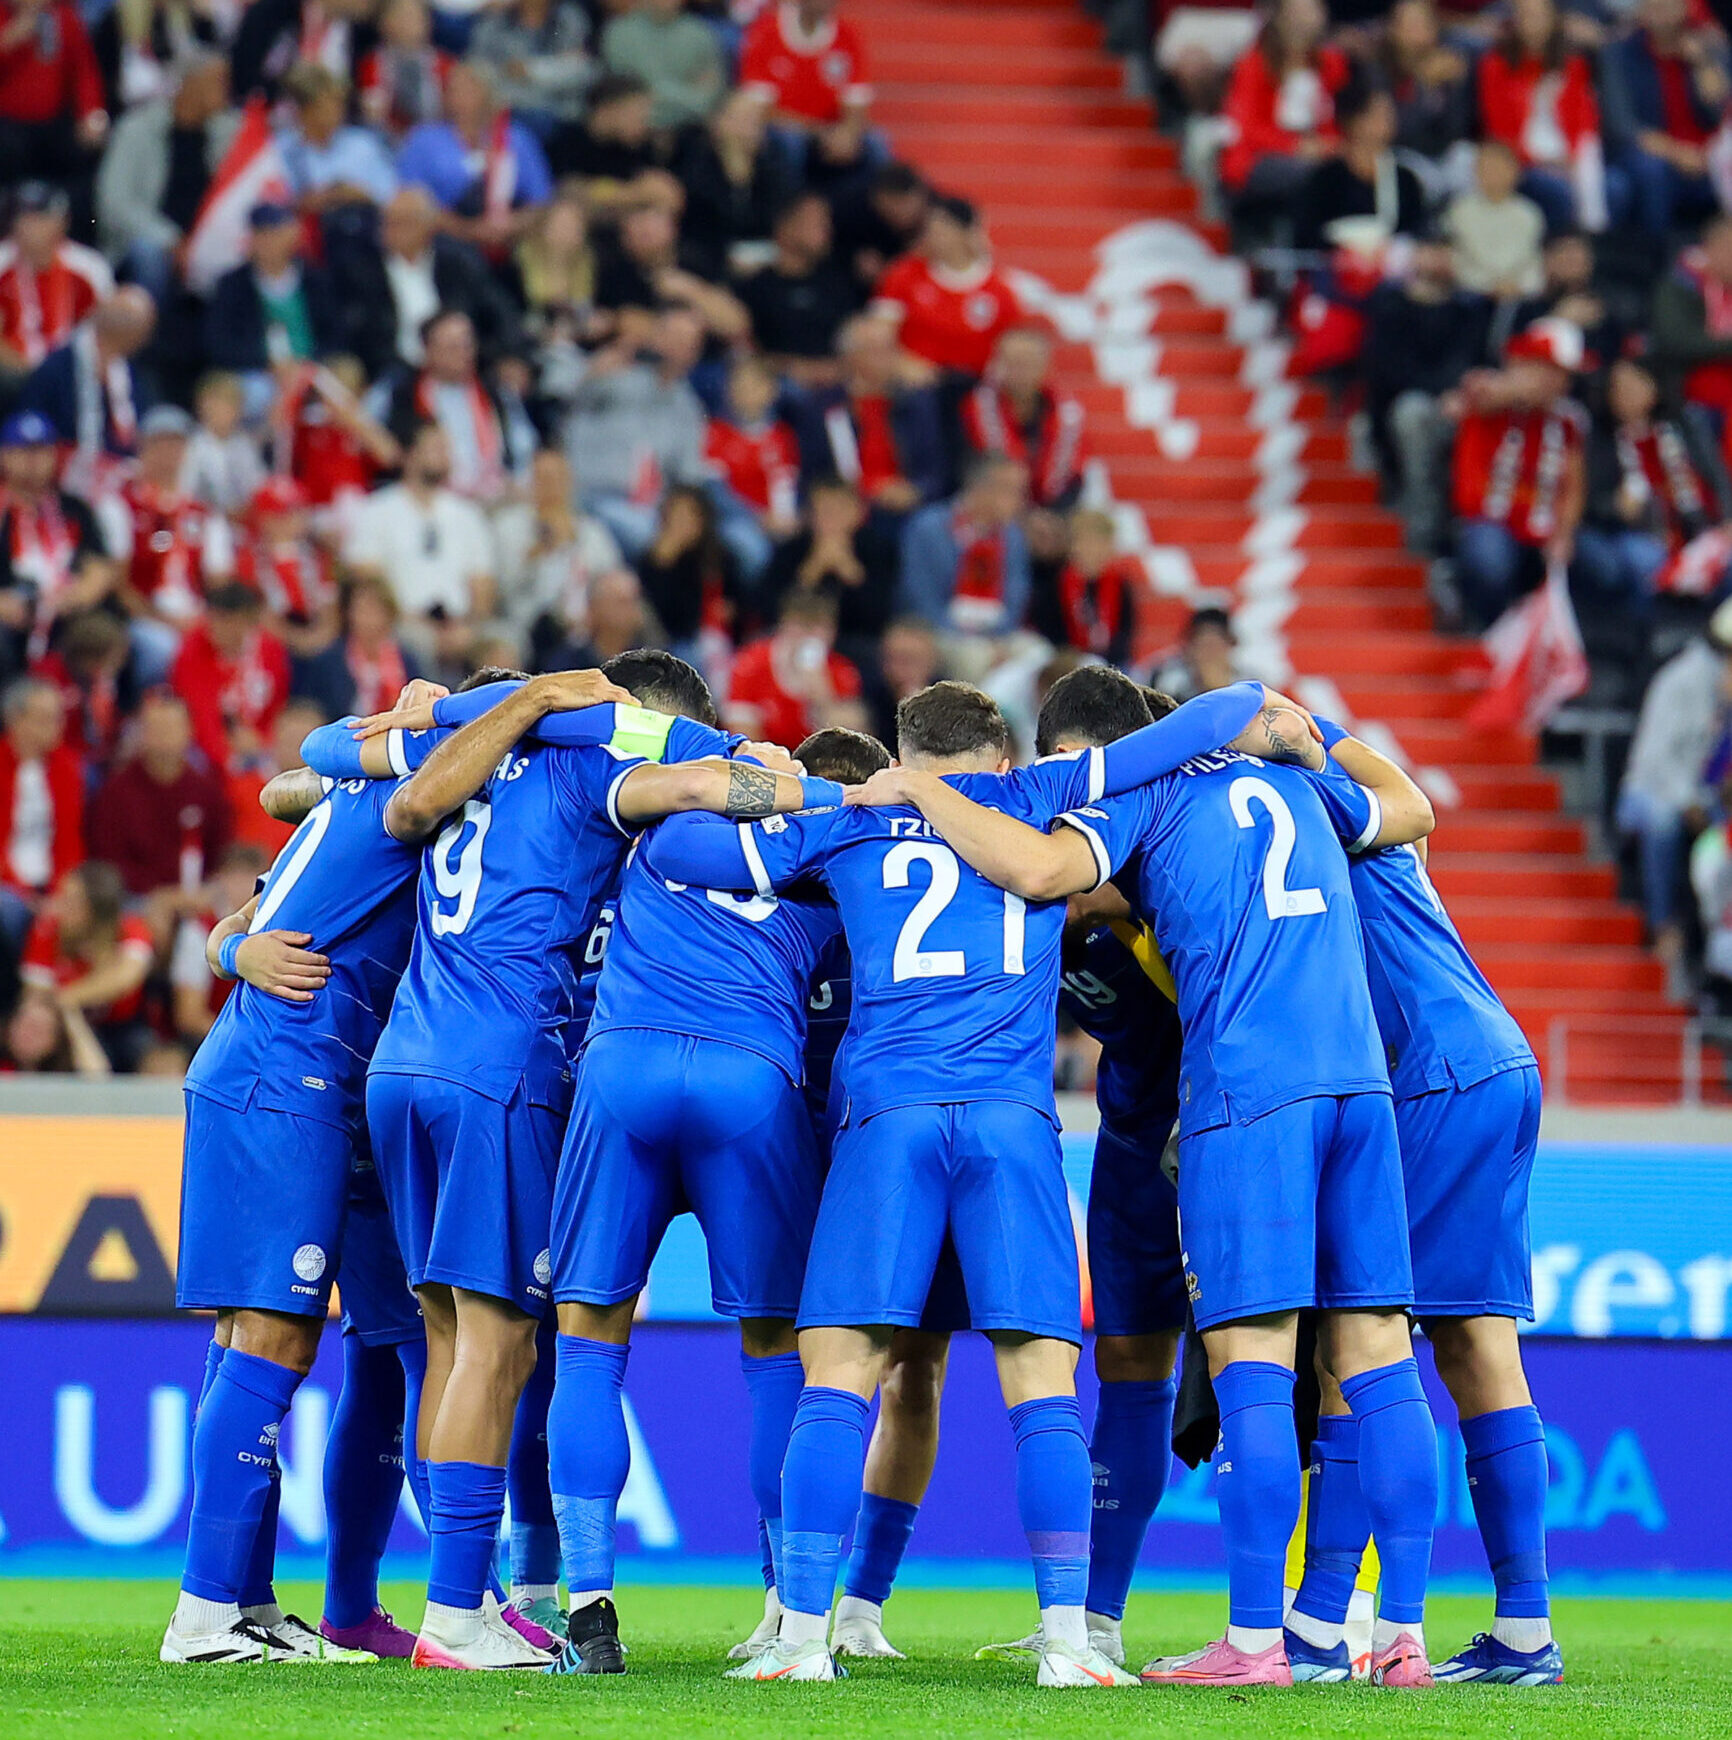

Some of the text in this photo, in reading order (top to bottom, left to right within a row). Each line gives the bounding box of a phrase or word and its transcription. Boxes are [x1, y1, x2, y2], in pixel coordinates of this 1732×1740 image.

[431, 799, 492, 937] 9
[882, 840, 1027, 984] 21
[1228, 775, 1328, 921] 2
